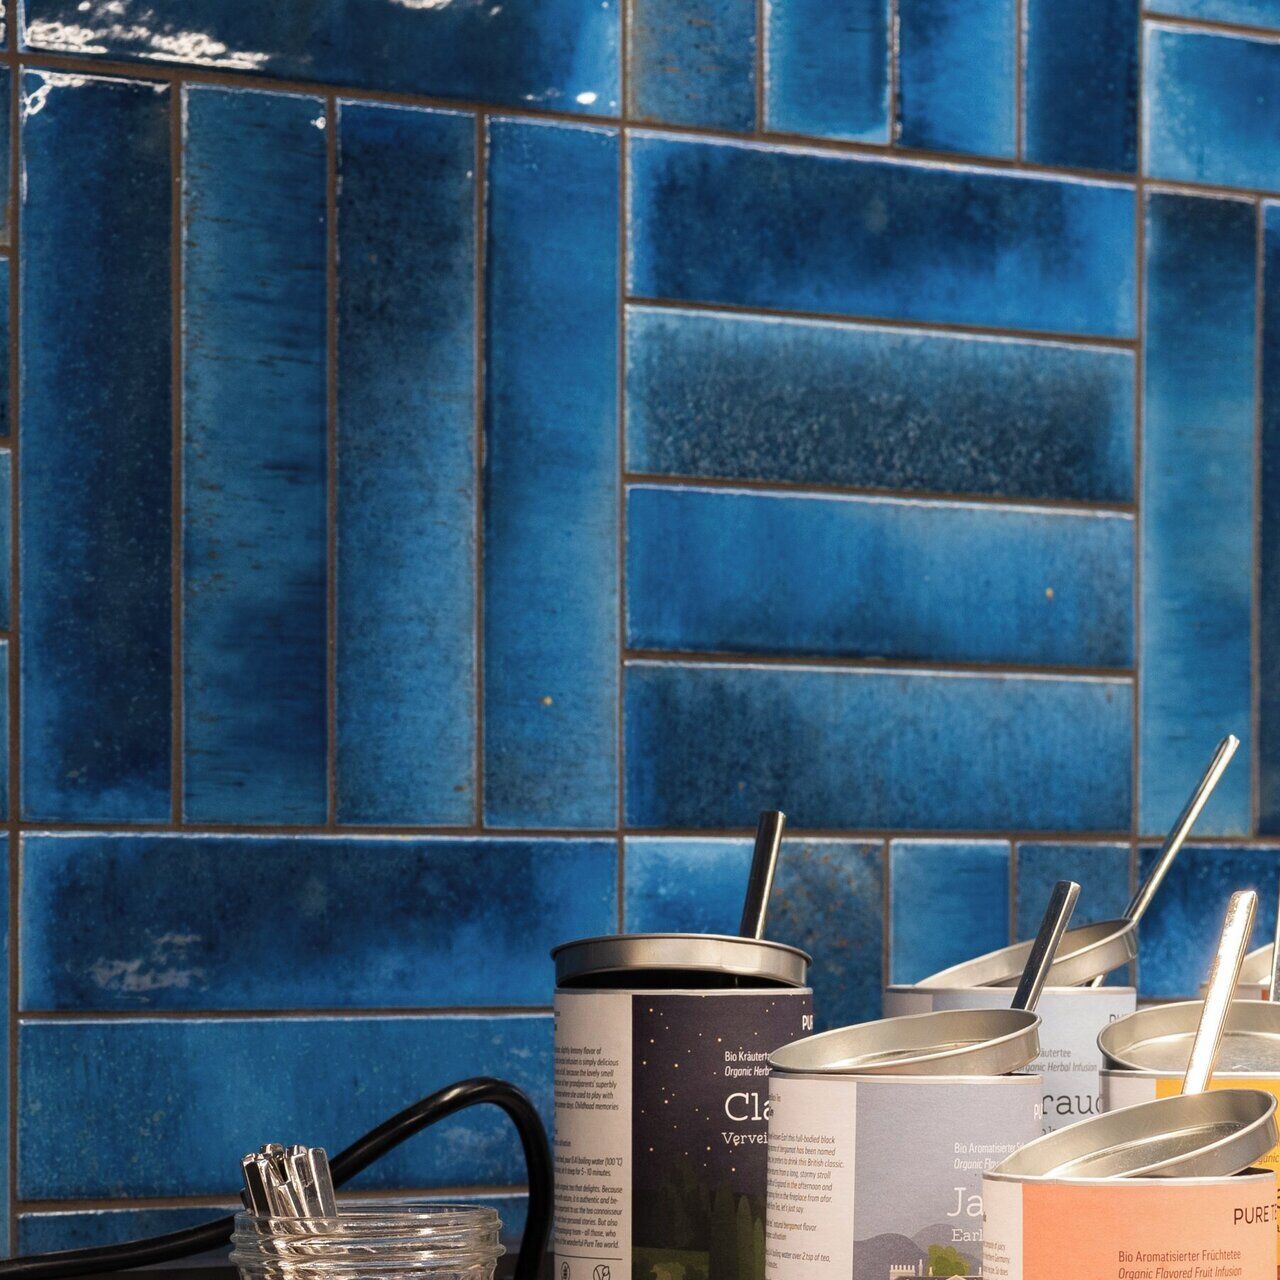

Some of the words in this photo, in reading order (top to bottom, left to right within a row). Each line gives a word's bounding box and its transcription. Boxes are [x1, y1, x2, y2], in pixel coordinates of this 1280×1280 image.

[724, 1051, 738, 1062] Bio
[724, 1066, 752, 1079] Organic
[753, 1065, 770, 1077] Herb
[817, 1148, 836, 1156] named
[954, 1142, 967, 1154] Bio
[953, 1158, 983, 1171] Organic
[601, 1185, 623, 1194] Because
[1233, 1205, 1269, 1225] PURE
[1118, 1251, 1134, 1263] Bio
[1135, 1250, 1200, 1263] Aromatisierter
[1201, 1249, 1242, 1261] Früchtetee
[1155, 1267, 1193, 1280] Flavored
[1194, 1266, 1214, 1279] Fruit
[1214, 1265, 1243, 1278] Infusion
